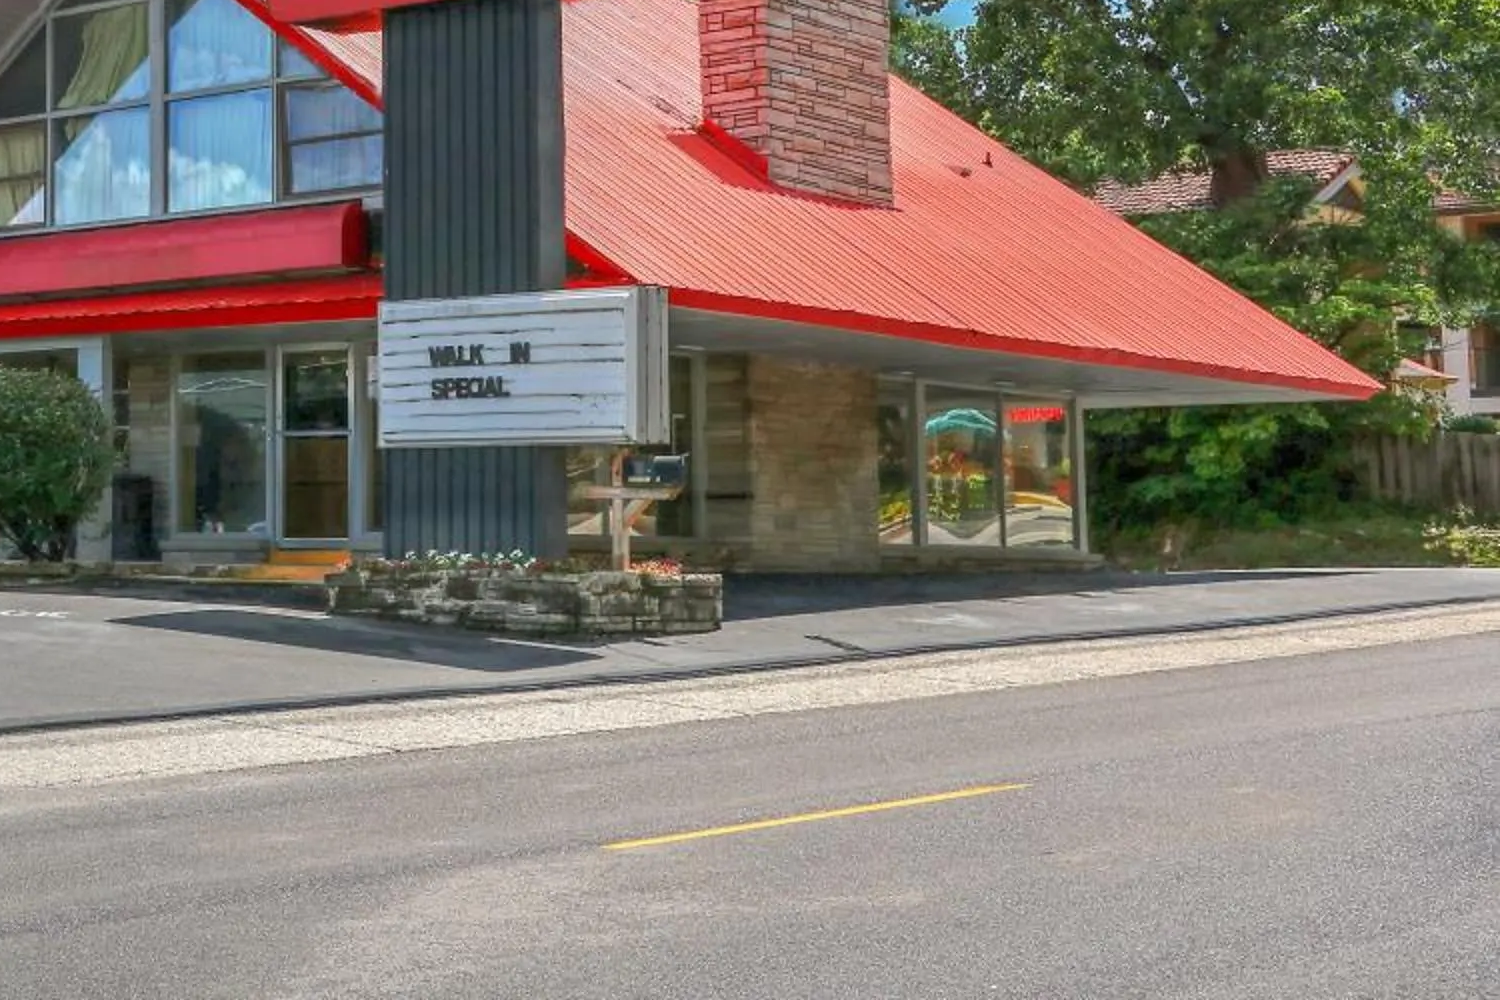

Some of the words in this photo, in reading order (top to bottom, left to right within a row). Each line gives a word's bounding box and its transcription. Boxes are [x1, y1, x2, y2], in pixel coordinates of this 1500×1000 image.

[428, 344, 484, 367] WALK
[510, 341, 531, 364] IN
[431, 376, 510, 399] SPECIAL
